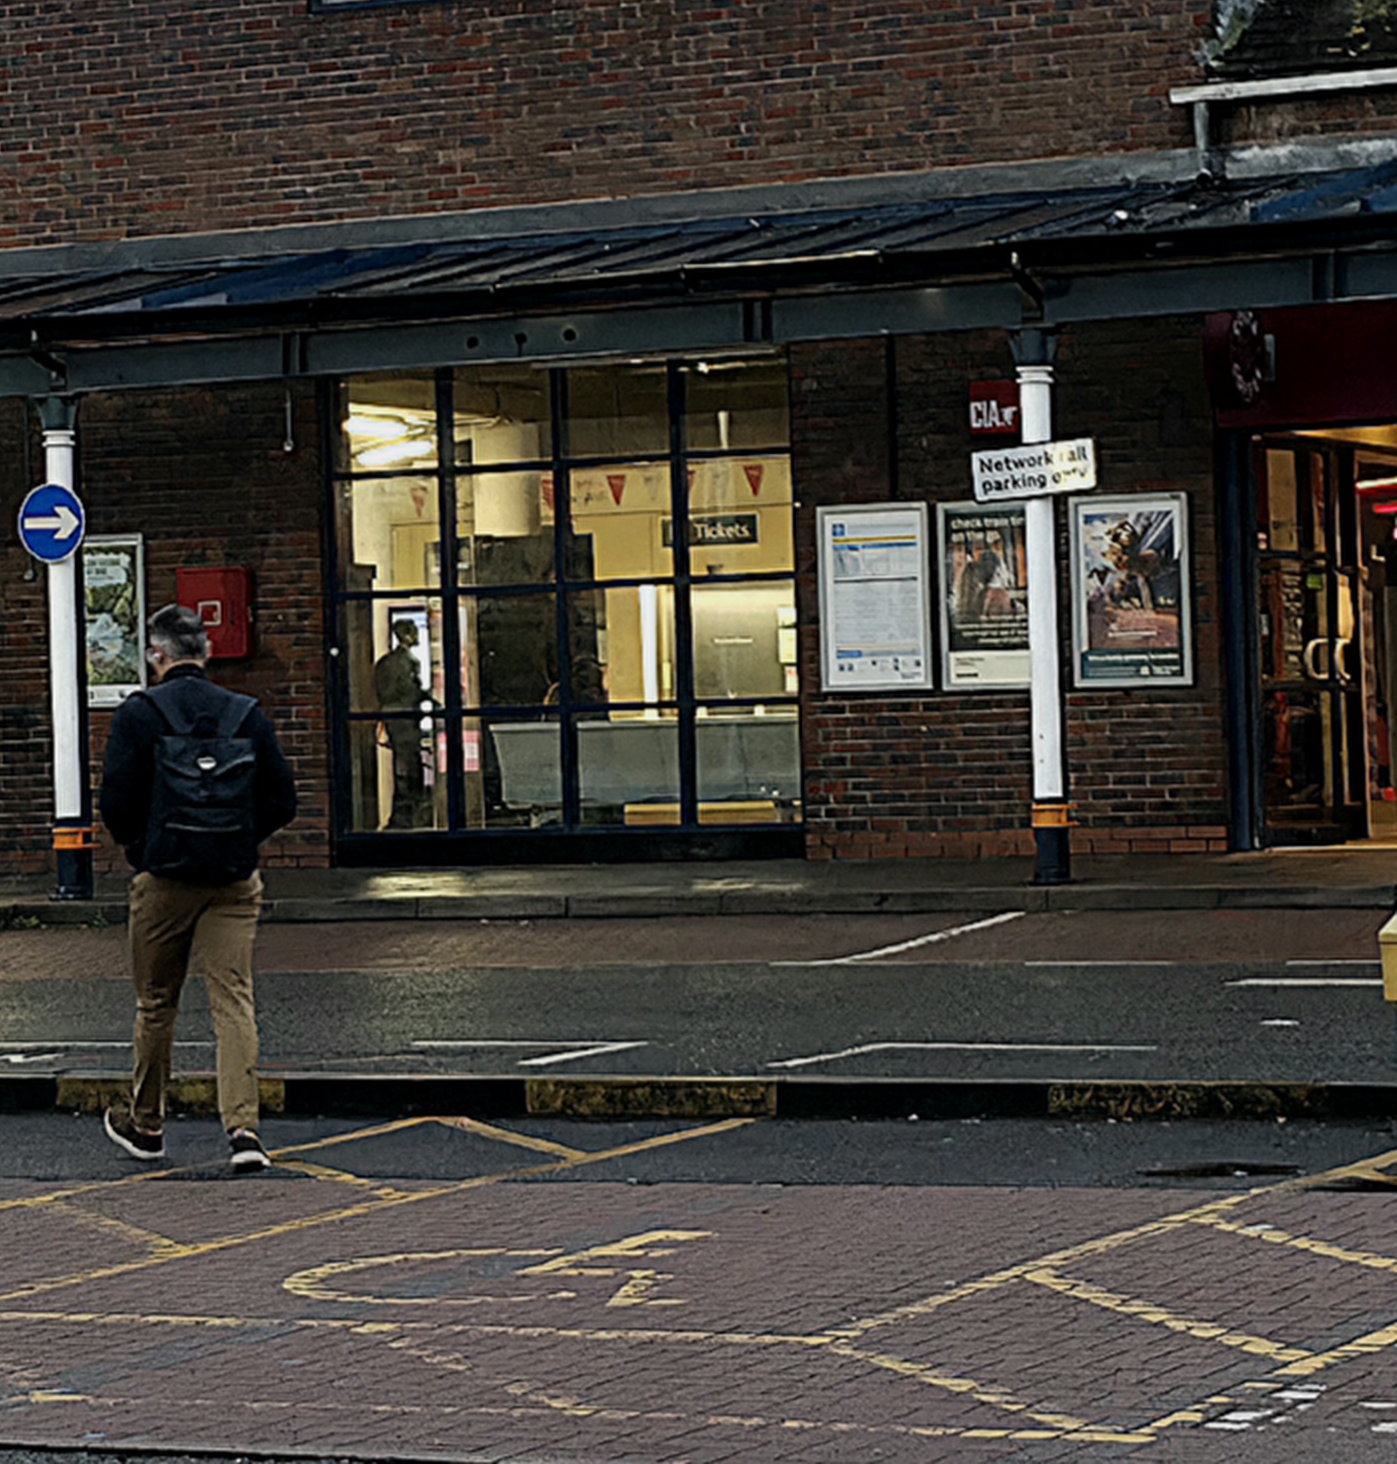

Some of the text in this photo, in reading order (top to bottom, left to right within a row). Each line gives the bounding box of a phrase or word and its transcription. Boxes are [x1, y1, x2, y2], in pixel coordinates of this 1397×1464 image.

[979, 450, 1053, 474] Network
[982, 473, 1047, 495] parking
[693, 521, 750, 539] Tickets
